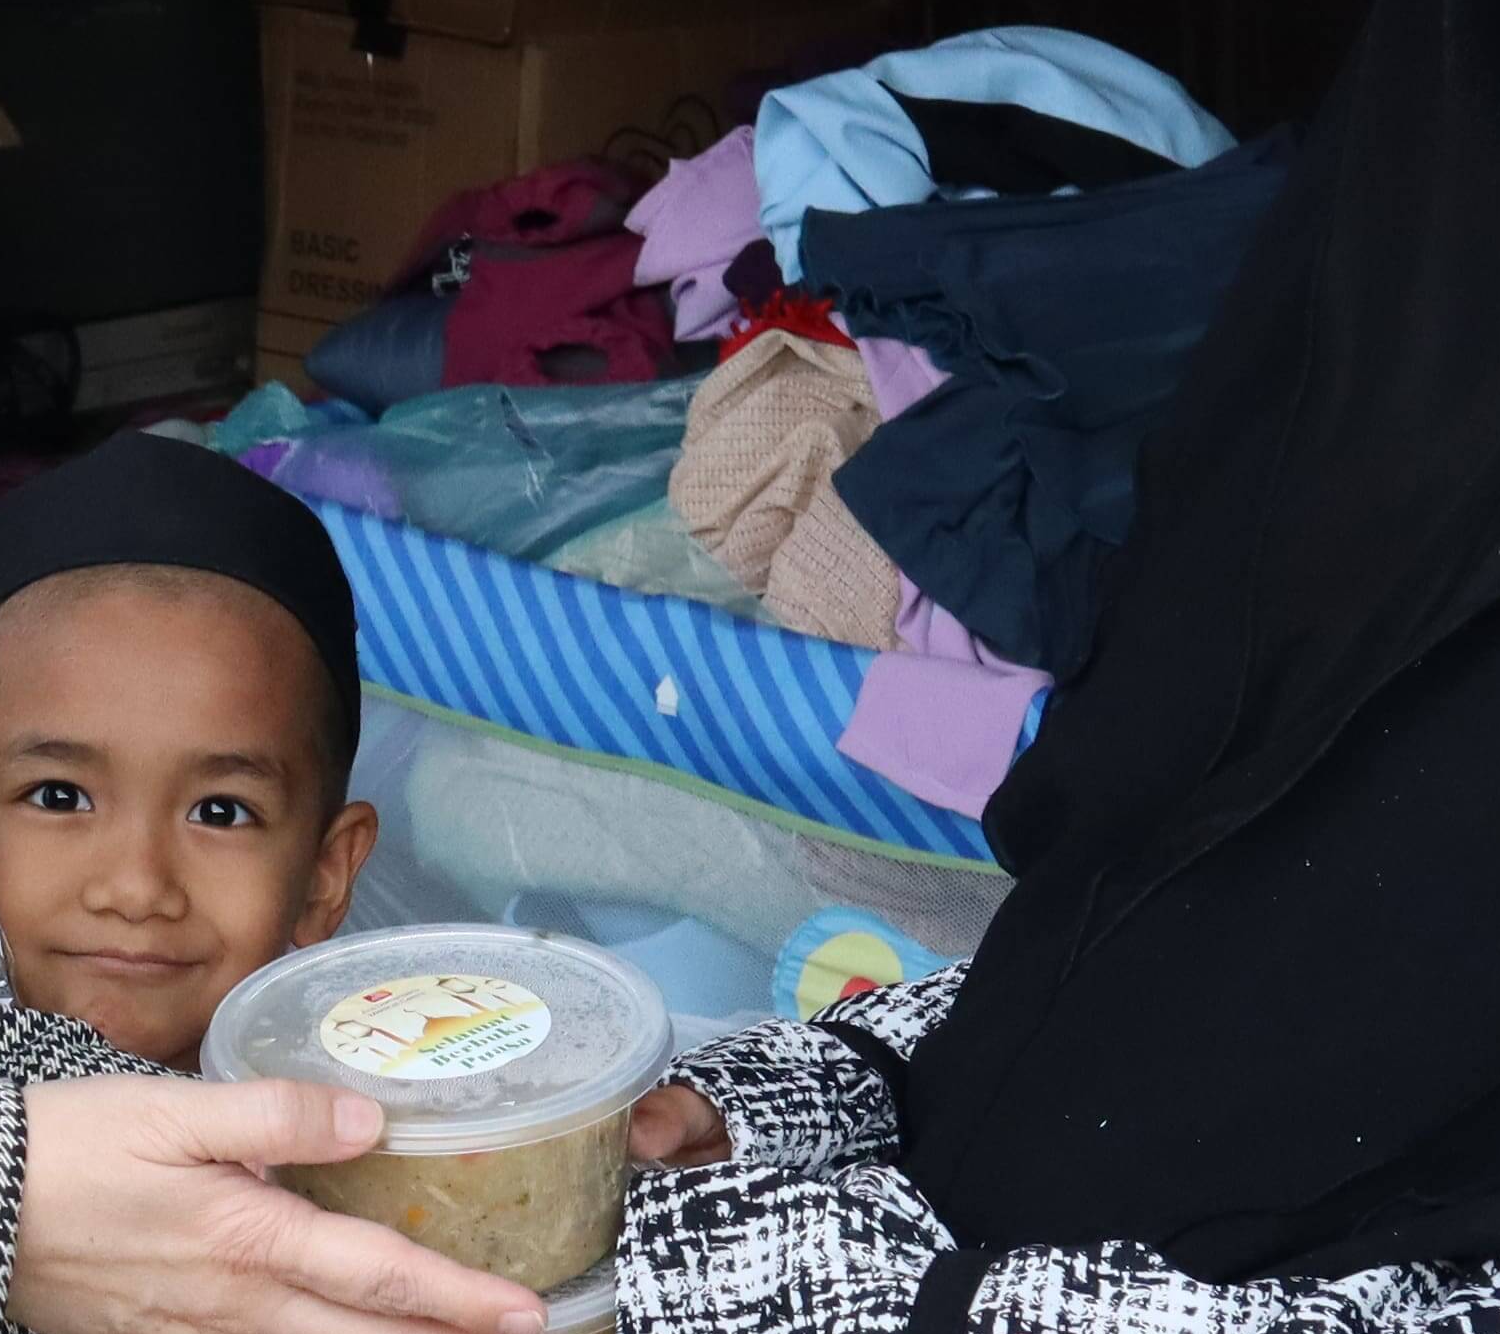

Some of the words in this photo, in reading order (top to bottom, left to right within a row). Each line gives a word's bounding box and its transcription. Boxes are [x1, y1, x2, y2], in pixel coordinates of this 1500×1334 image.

[289, 230, 360, 264] BASIC
[418, 1013, 512, 1053] Selamat
[431, 1023, 530, 1067] Berbuka
[460, 1037, 532, 1069] Puasa
